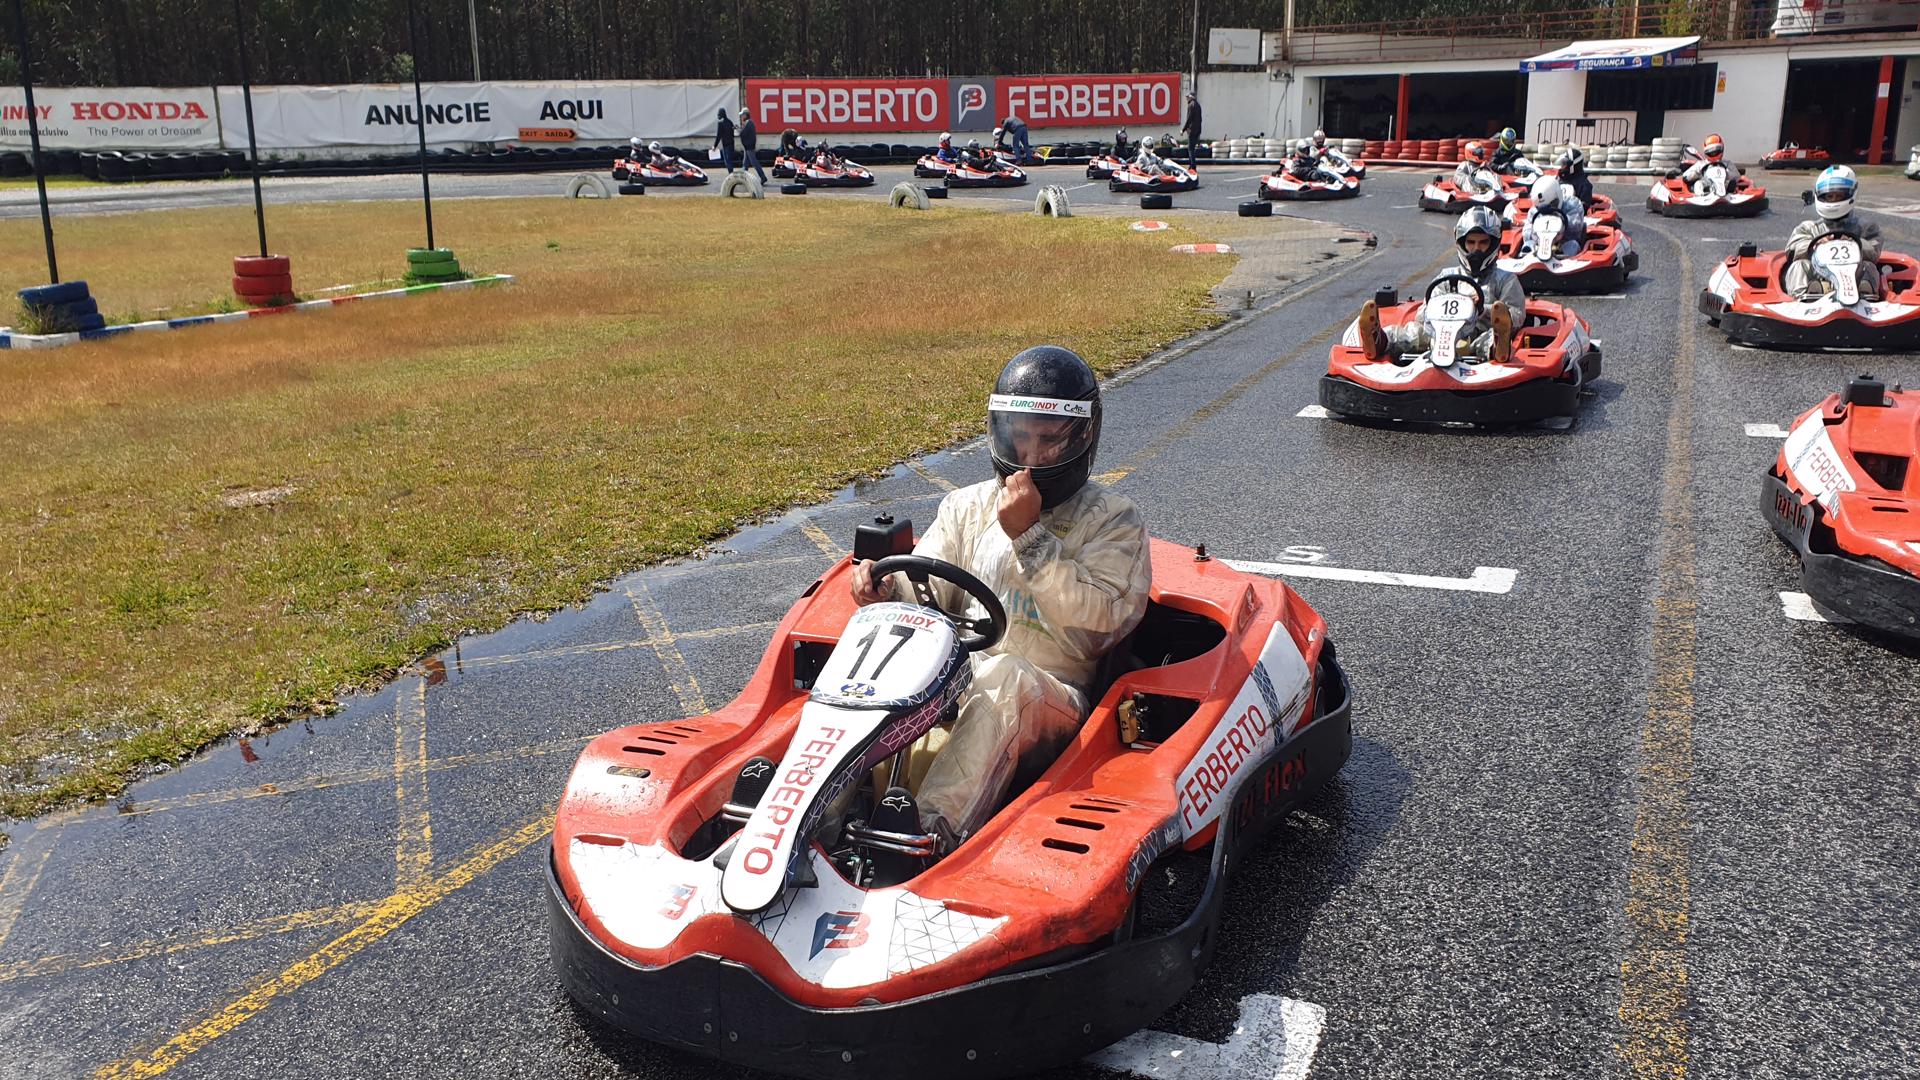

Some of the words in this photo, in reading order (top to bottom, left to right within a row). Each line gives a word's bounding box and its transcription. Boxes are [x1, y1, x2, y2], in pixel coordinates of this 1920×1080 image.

[1579, 59, 1625, 67] SEGURANÇA
[759, 86, 939, 123] FERBERTO
[1008, 82, 1171, 119] FERBERTO
[0, 106, 52, 120] INY
[70, 102, 208, 120] HONDA
[365, 102, 491, 126] ANUNCIE
[540, 99, 603, 121] AQUI
[38, 126, 69, 137] xclusivo
[88, 127, 109, 136] The
[111, 127, 144, 136] Power
[161, 126, 201, 136] Dreams
[1830, 245, 1851, 260] 23
[1441, 300, 1459, 315] 18
[1009, 399, 1059, 410] EUROINDY
[857, 612, 937, 628] EUROINDY
[846, 624, 916, 681] 17
[1178, 704, 1266, 830] FERBERTO
[743, 726, 846, 875] FERBERTO
